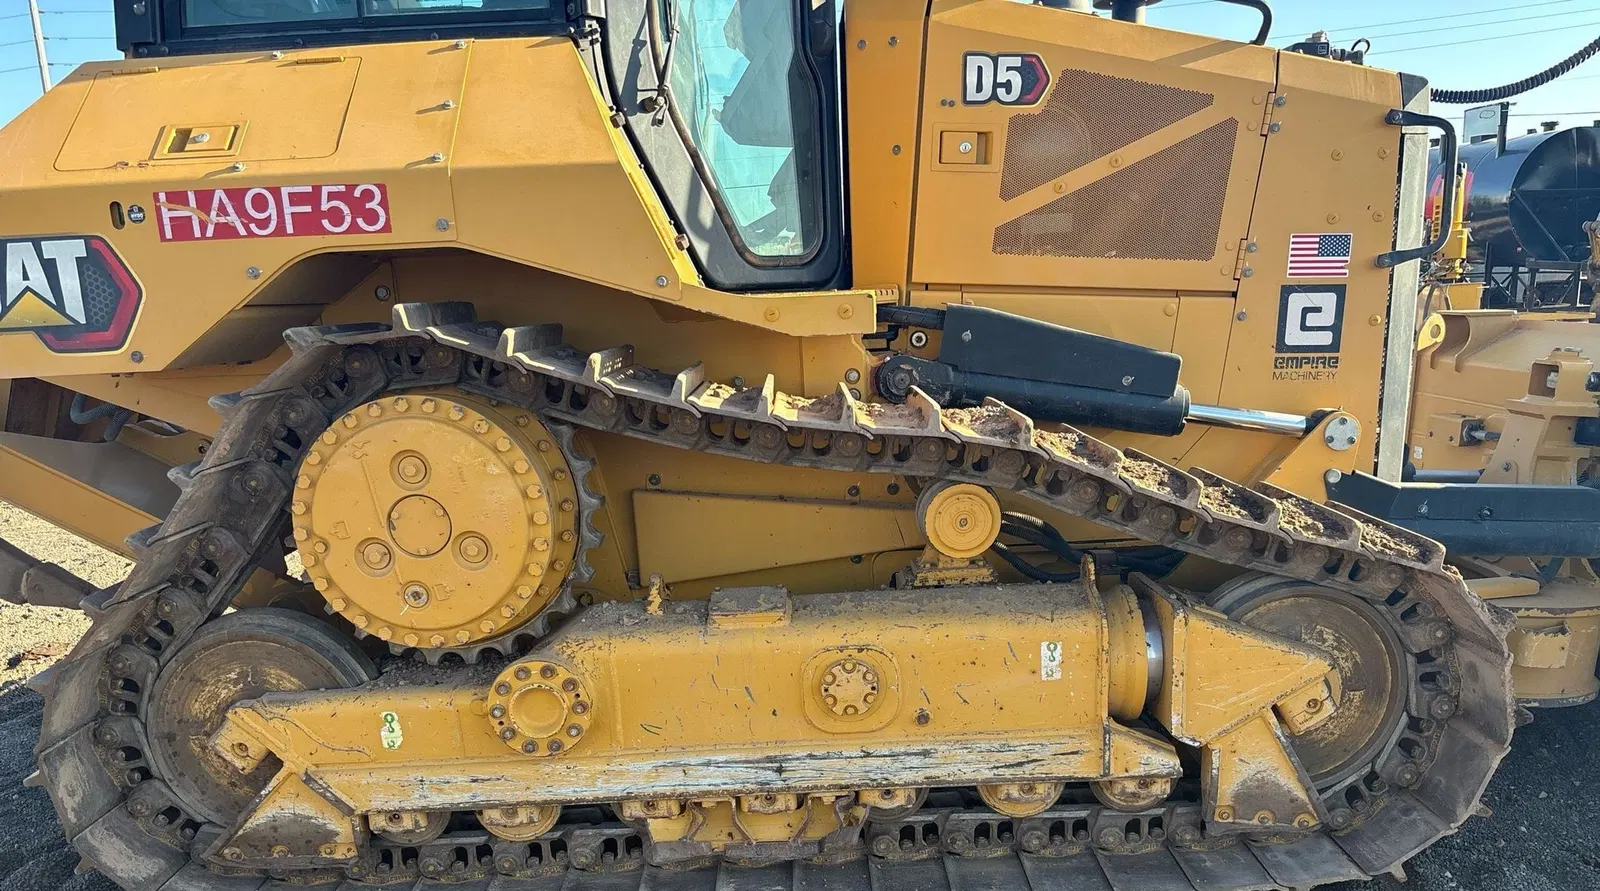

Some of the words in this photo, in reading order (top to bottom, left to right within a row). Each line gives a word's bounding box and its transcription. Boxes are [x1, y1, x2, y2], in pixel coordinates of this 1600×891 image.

[966, 56, 1022, 102] D5
[156, 184, 387, 239] HA9F53
[0, 239, 87, 324] AT
[1272, 371, 1338, 381] MACHINERY
